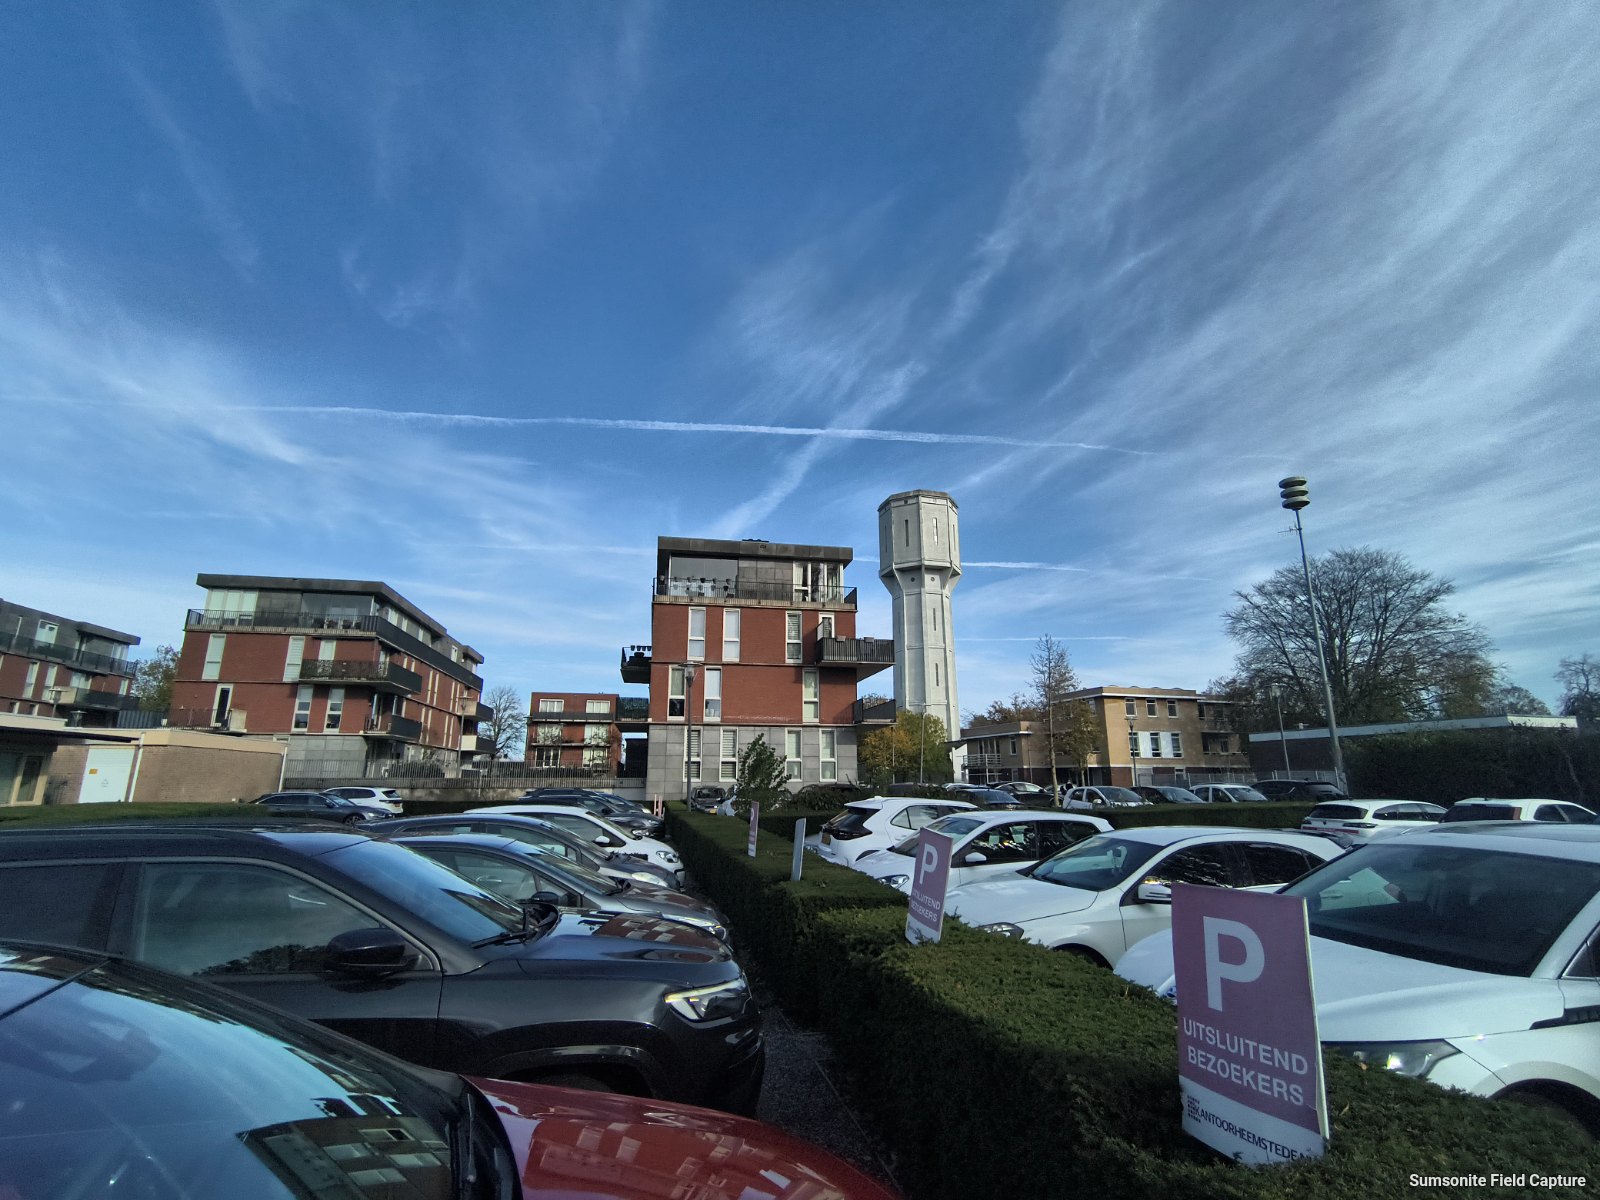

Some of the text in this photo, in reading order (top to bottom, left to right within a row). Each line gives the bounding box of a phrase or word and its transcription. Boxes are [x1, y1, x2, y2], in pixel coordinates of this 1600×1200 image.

[919, 843, 939, 885] P
[1202, 915, 1265, 1012] P
[1182, 1016, 1309, 1076] UITSLUITEND
[1187, 1045, 1304, 1106] BEZOEKERS
[1195, 1106, 1312, 1161] KANTOORHEEMSTEDE
